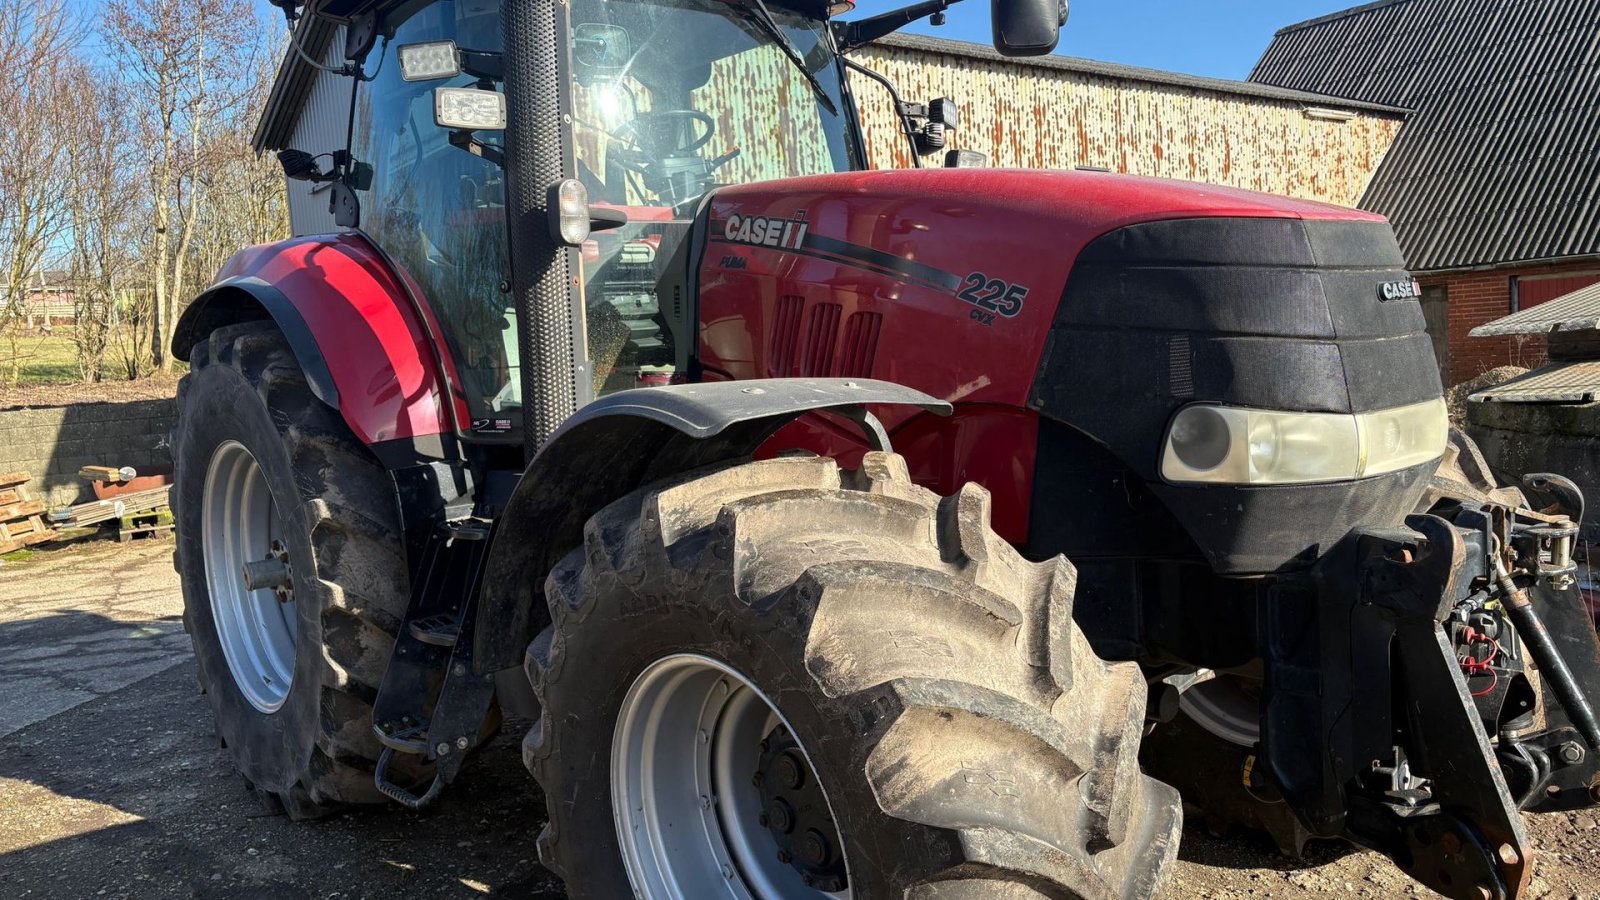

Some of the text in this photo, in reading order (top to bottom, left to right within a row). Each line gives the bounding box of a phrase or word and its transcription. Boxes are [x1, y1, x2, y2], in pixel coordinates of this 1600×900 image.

[725, 214, 783, 246] CASE
[957, 271, 1029, 318] 225
[1383, 282, 1412, 299] CASE
[970, 309, 996, 325] CVX
